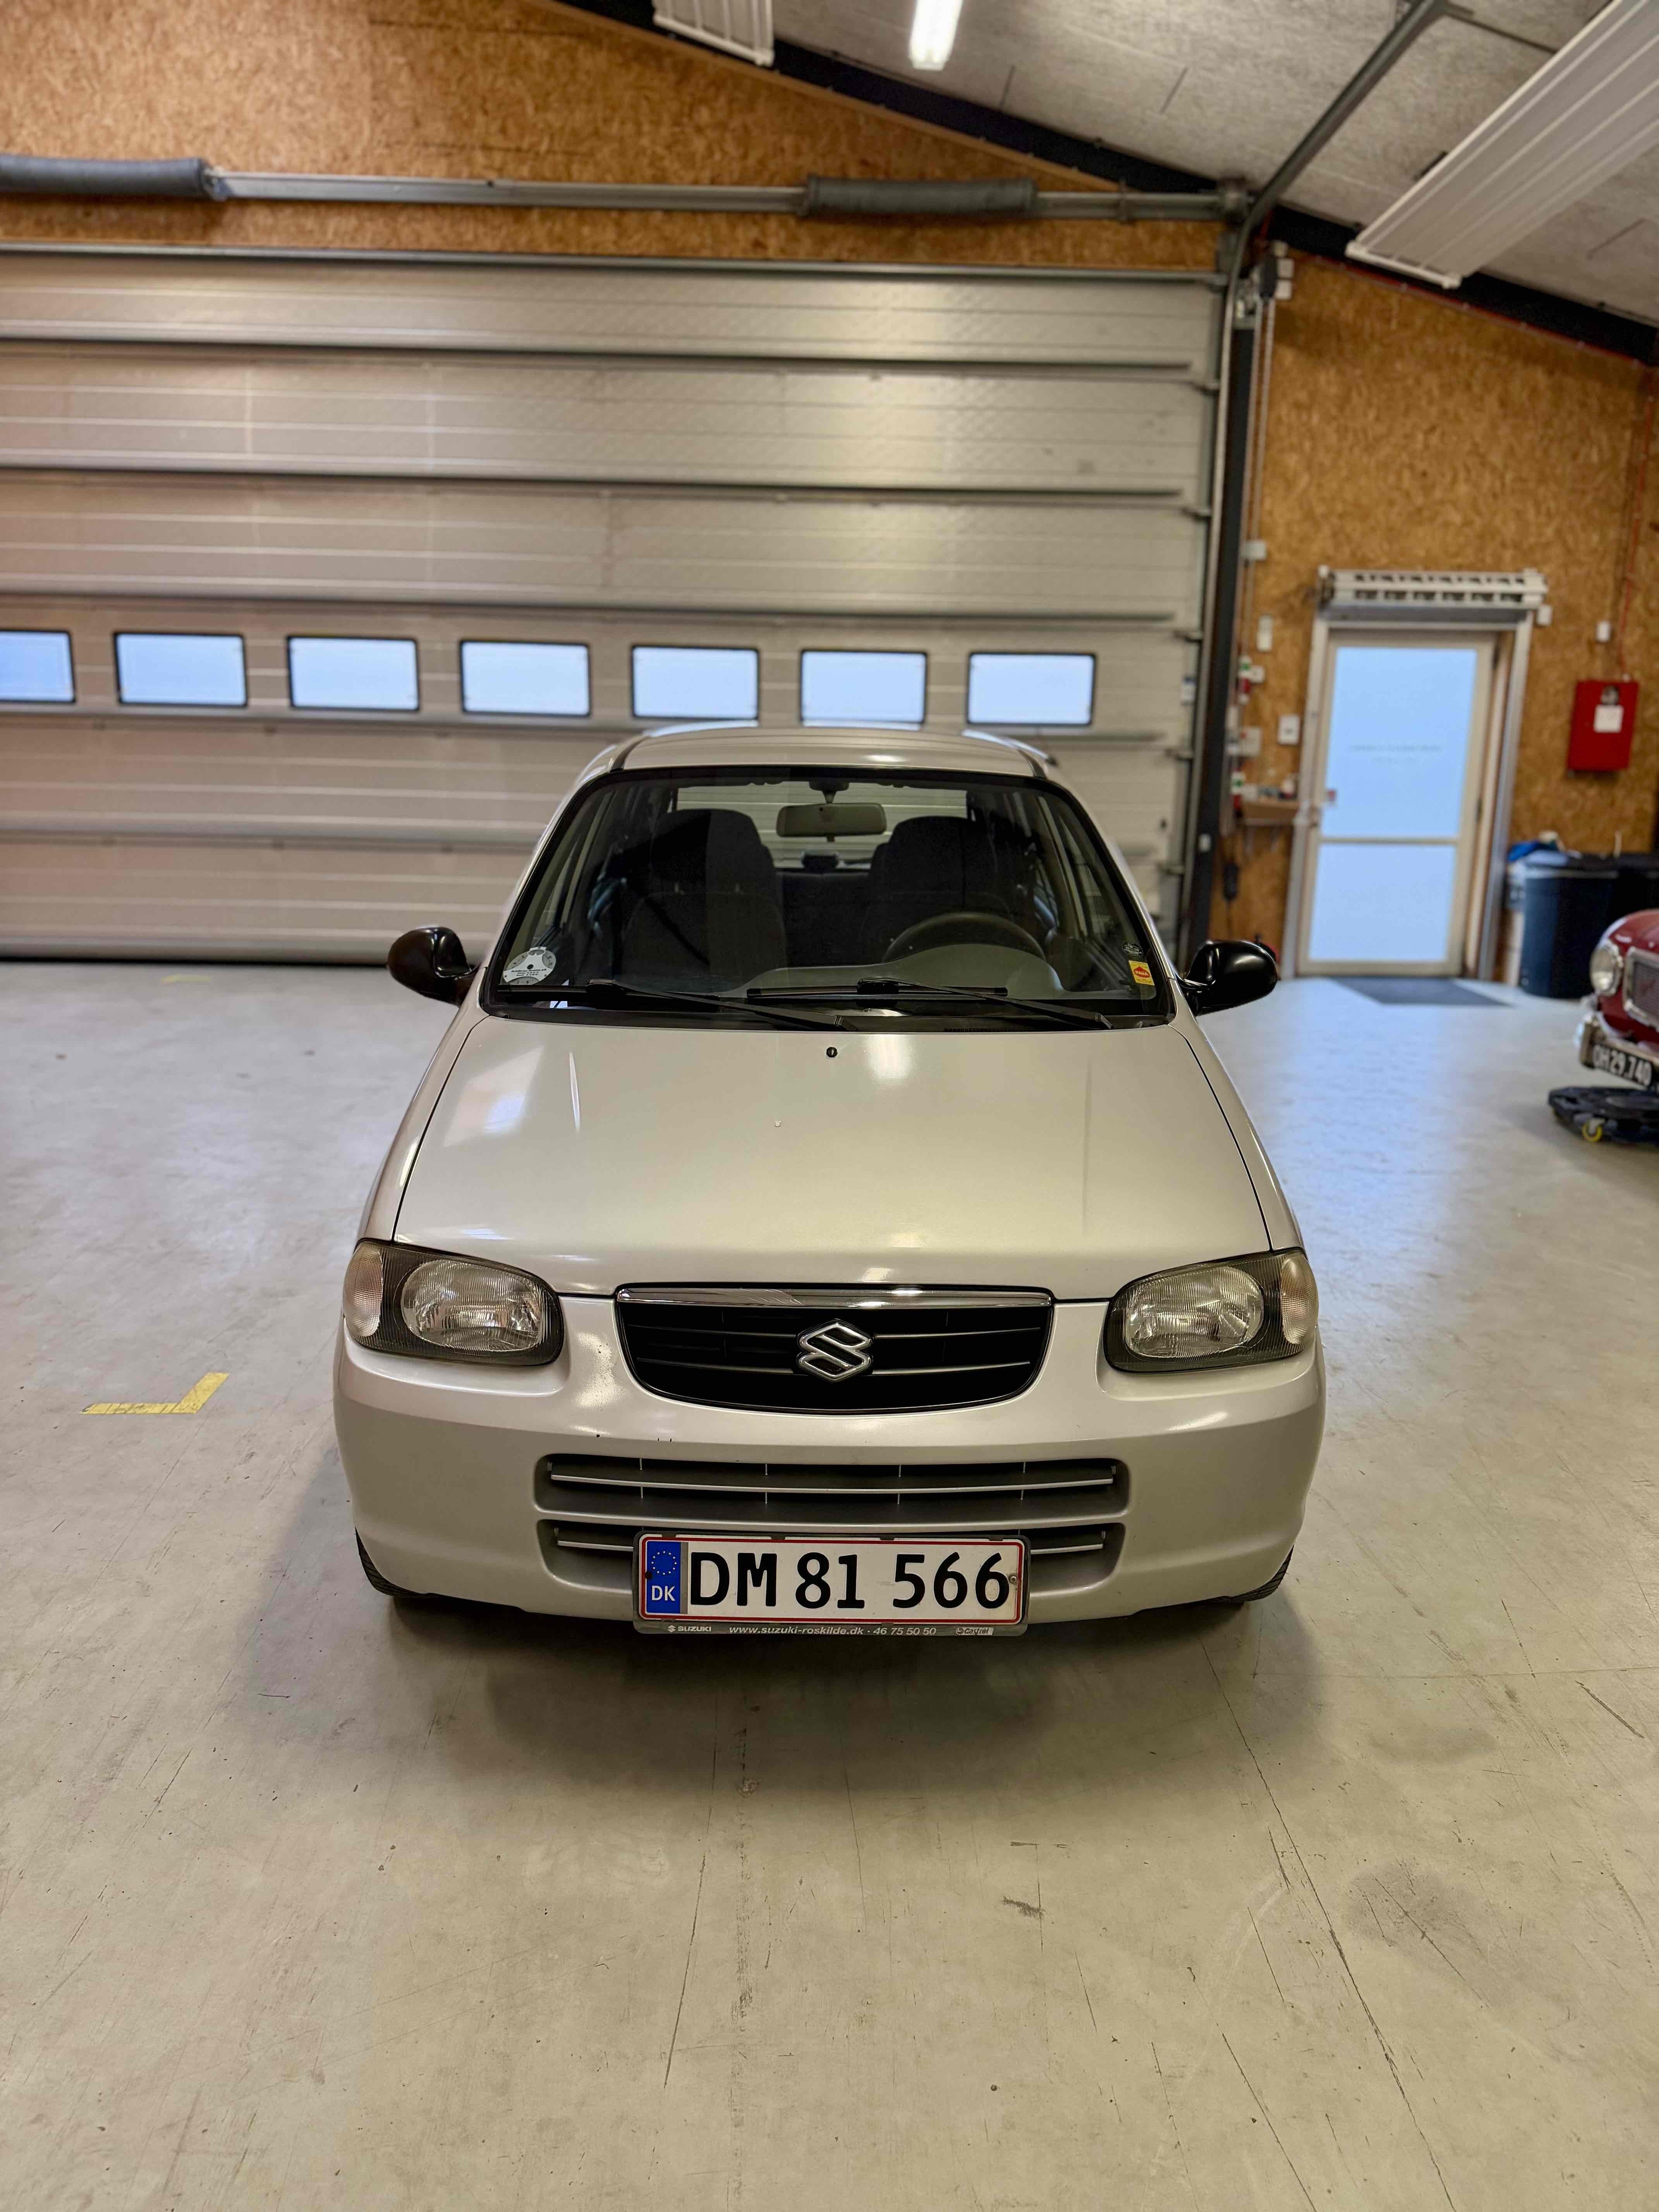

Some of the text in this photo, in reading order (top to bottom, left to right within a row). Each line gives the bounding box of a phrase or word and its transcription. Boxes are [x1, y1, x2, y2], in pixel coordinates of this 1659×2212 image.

[690, 1552, 1010, 1609] DM 81 566
[651, 1585, 675, 1601] DK
[729, 1626, 864, 1635] www.suzuki-roskilde.dk
[923, 1627, 937, 1635] 50
